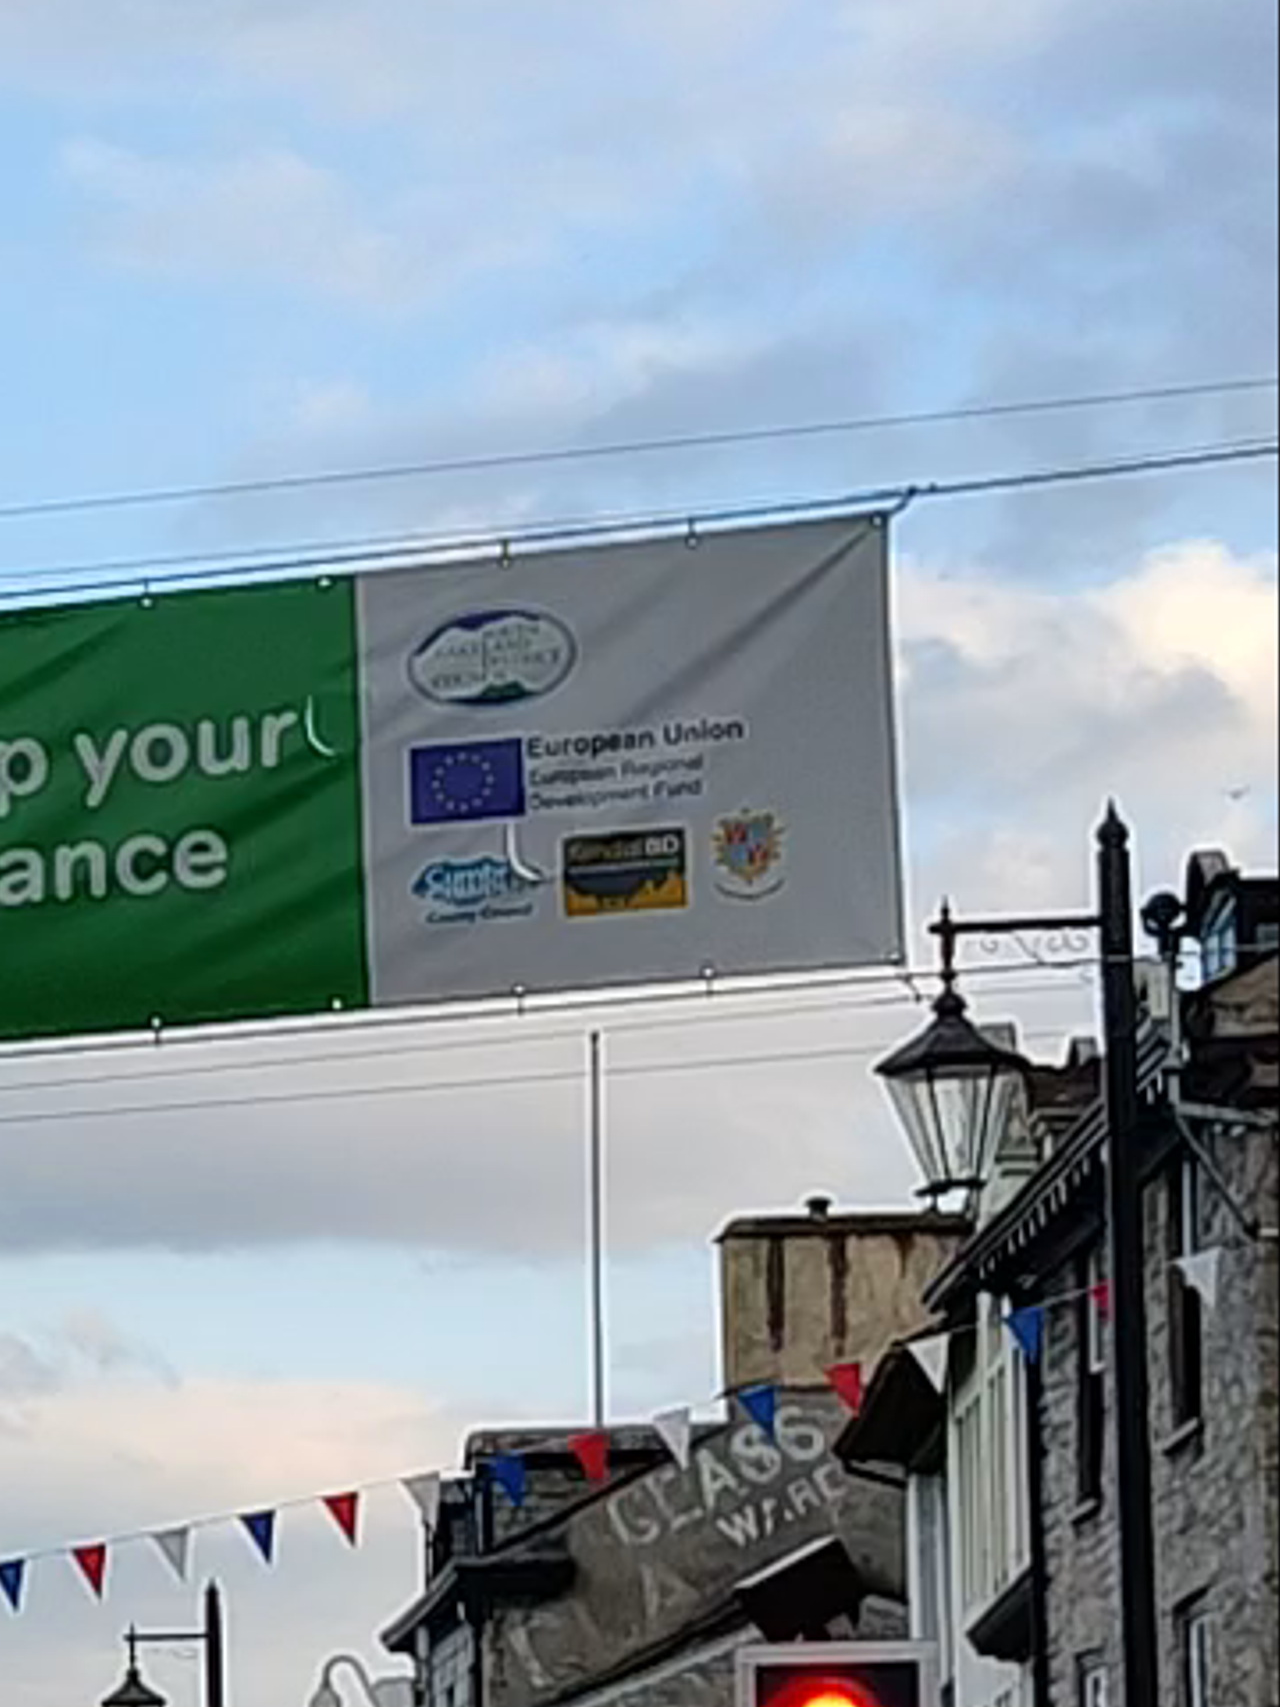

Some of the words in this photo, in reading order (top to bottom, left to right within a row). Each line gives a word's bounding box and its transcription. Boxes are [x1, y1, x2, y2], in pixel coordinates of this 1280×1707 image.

[73, 709, 299, 808] your
[527, 730, 655, 760] European
[662, 718, 744, 746] Union
